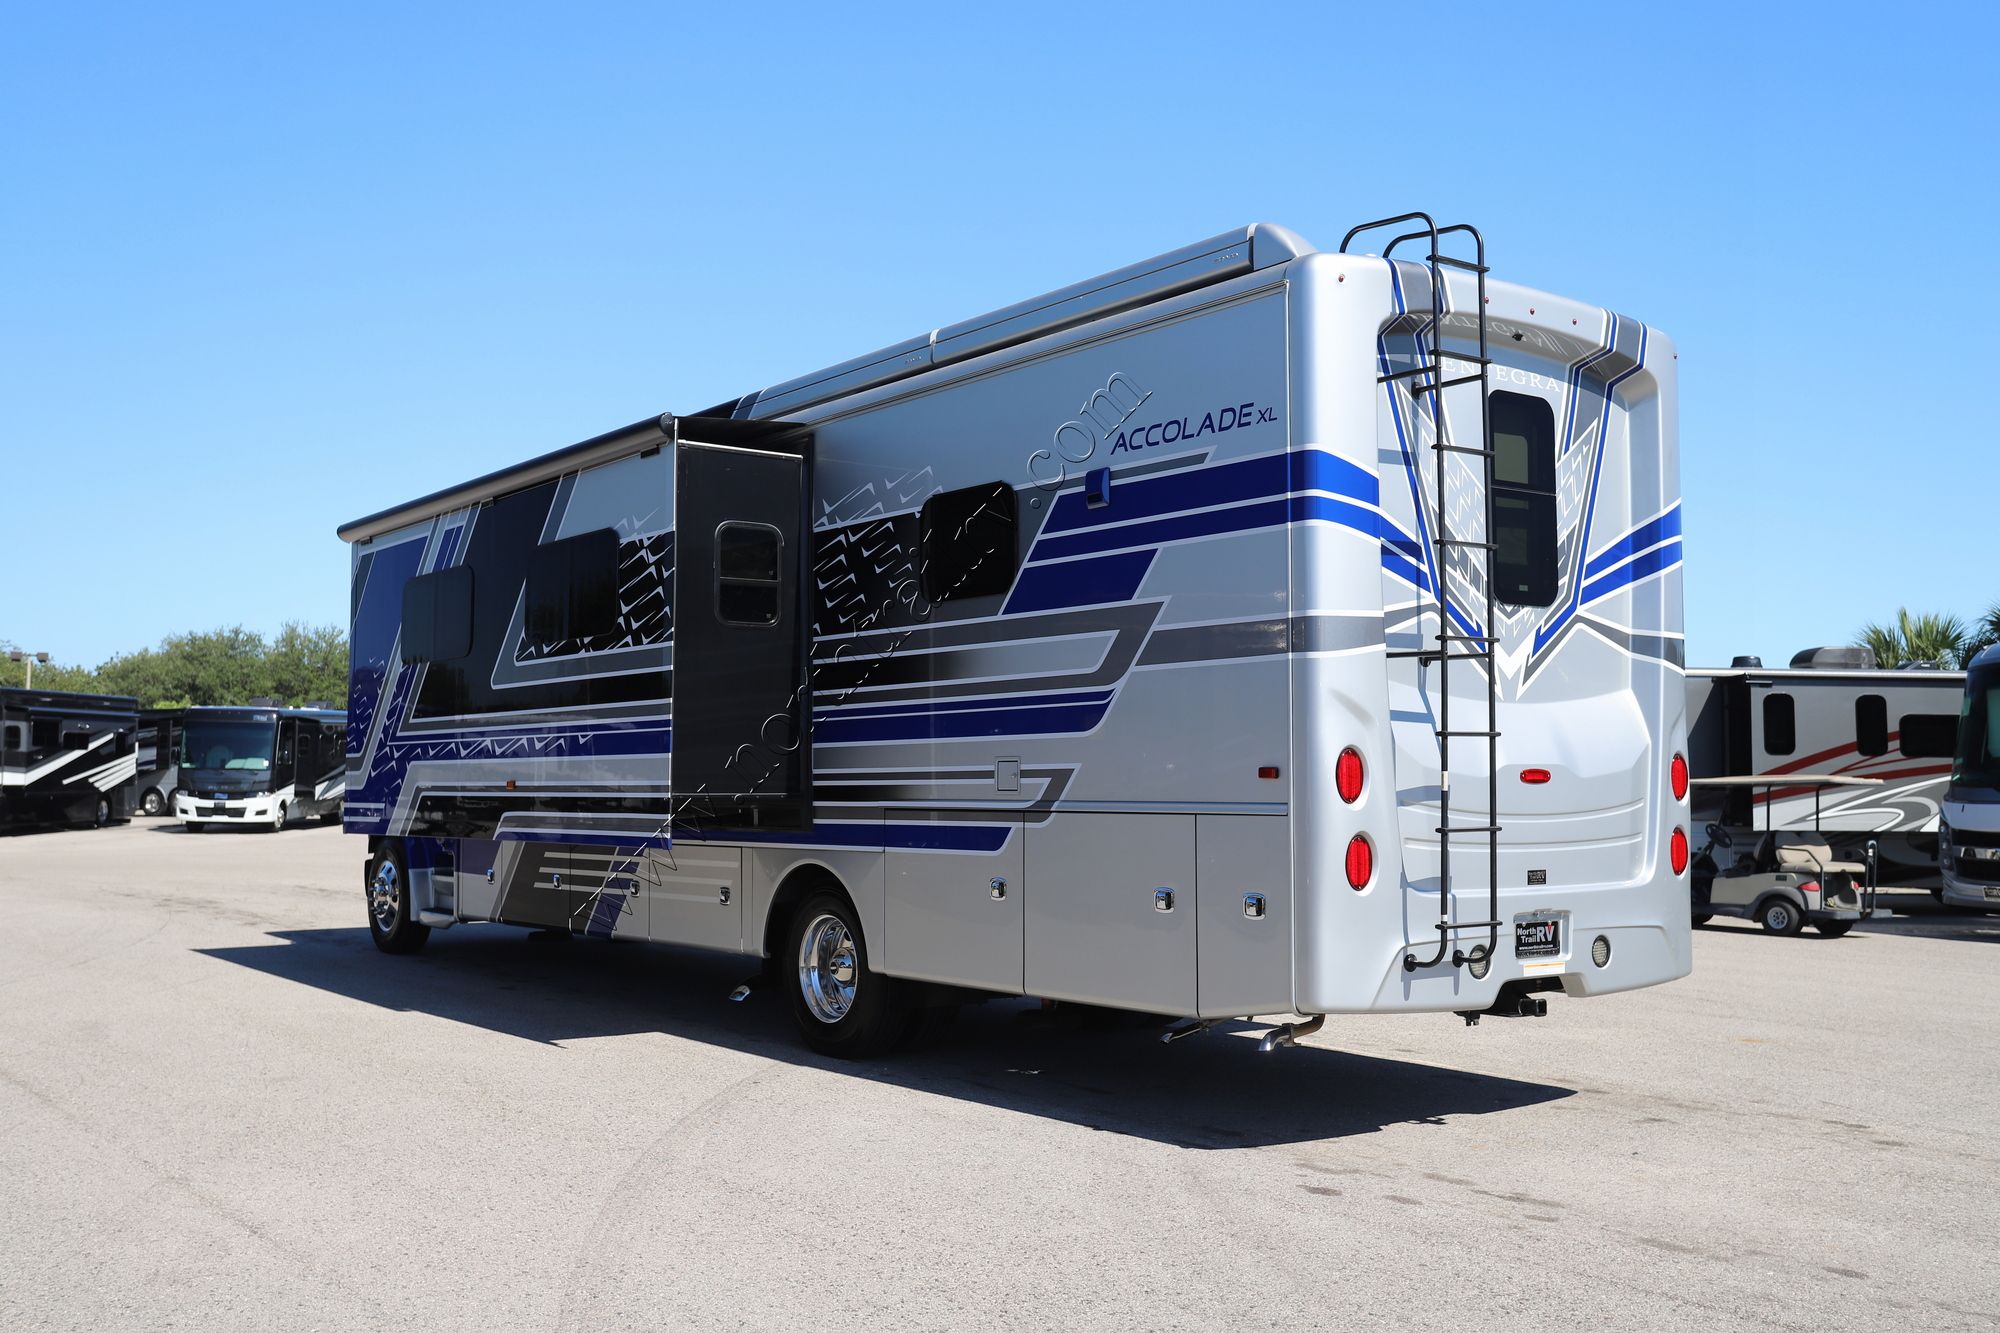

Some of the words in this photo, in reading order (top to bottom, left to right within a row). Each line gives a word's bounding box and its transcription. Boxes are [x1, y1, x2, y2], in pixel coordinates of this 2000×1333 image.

[1441, 356, 1561, 393] ENEGRA
[1110, 402, 1255, 455] ACCOLADE
[1256, 406, 1278, 425] XL
[1518, 927, 1536, 936] North
[1537, 926, 1555, 942] RV
